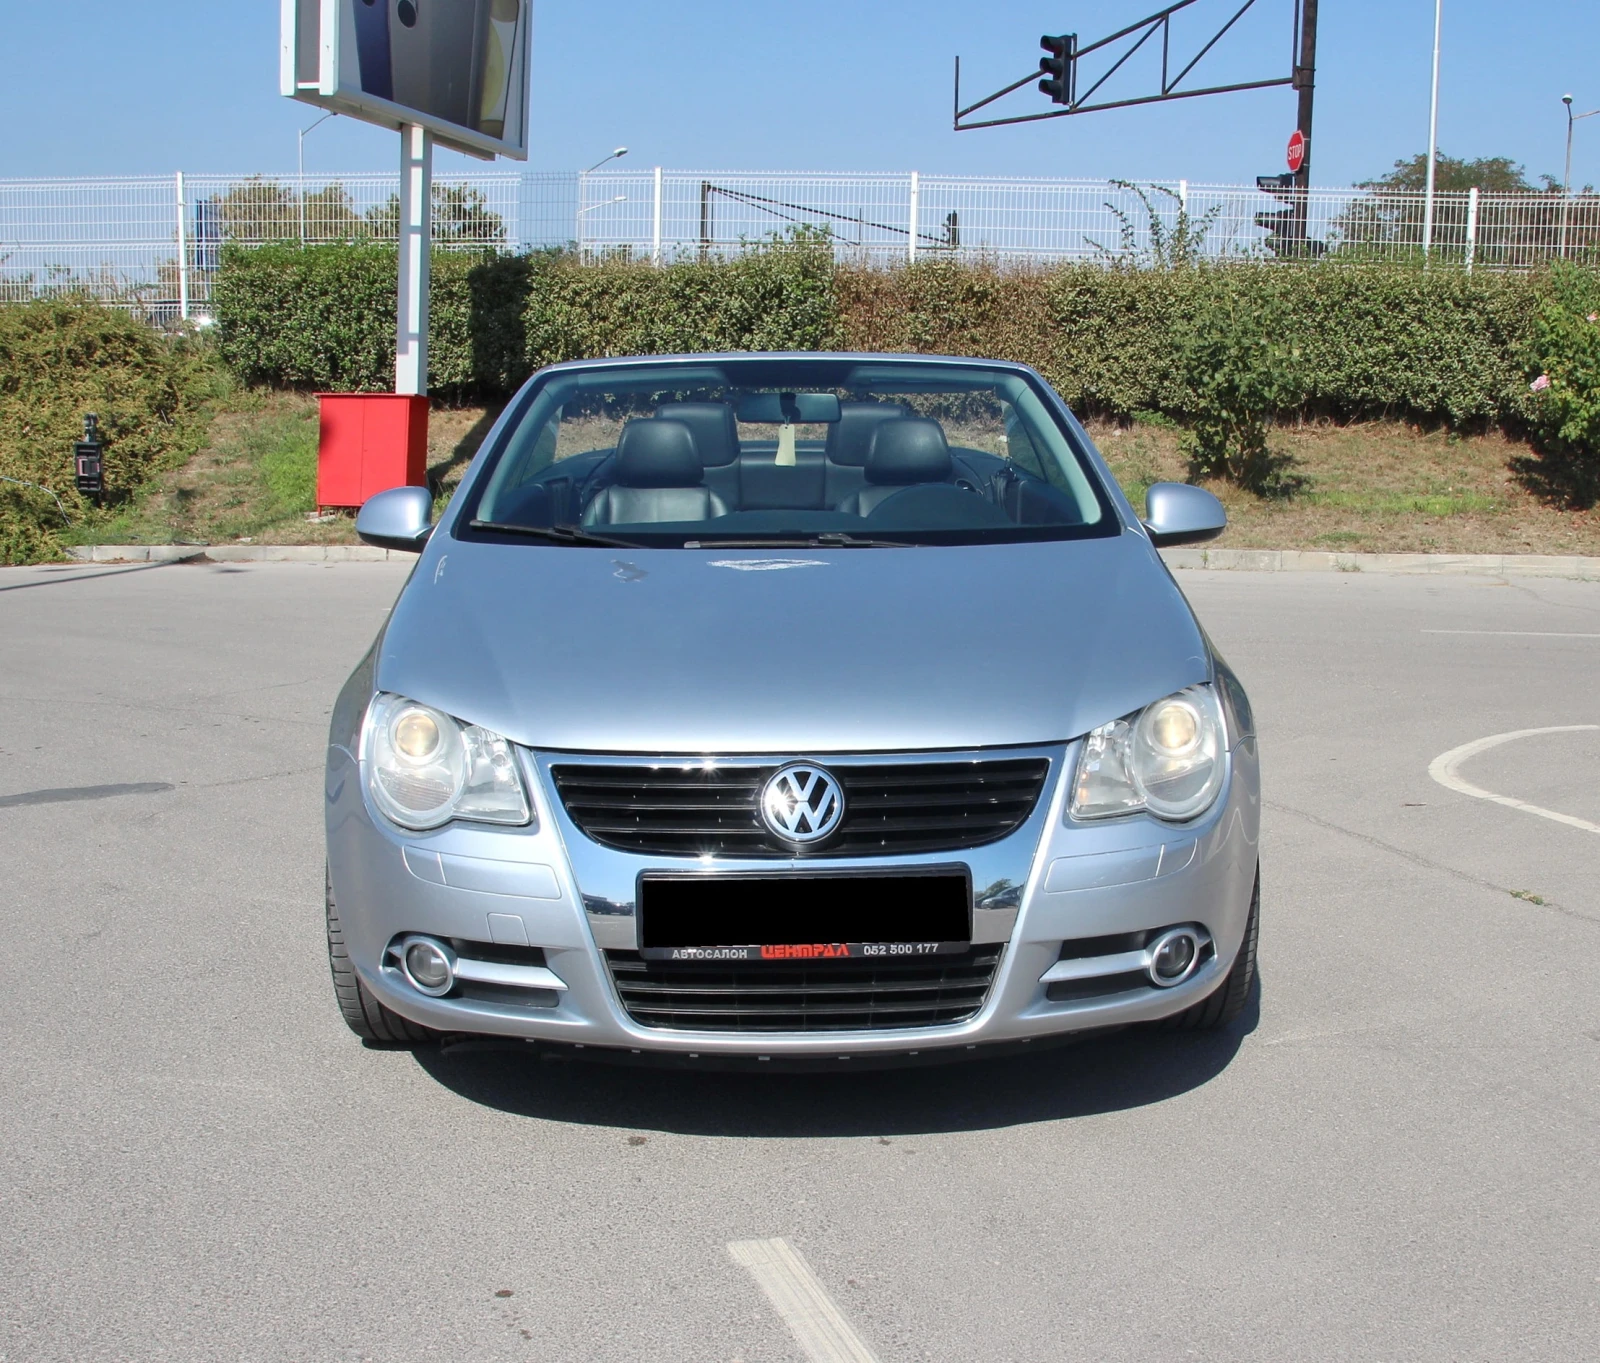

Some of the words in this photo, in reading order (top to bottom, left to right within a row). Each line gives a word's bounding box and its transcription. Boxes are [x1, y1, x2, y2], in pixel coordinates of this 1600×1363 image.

[1288, 143, 1301, 160] STOP
[672, 949, 748, 959] АВТОСАЛОН
[863, 945, 887, 955] 052
[890, 944, 913, 954] 500
[916, 943, 939, 953] 177
